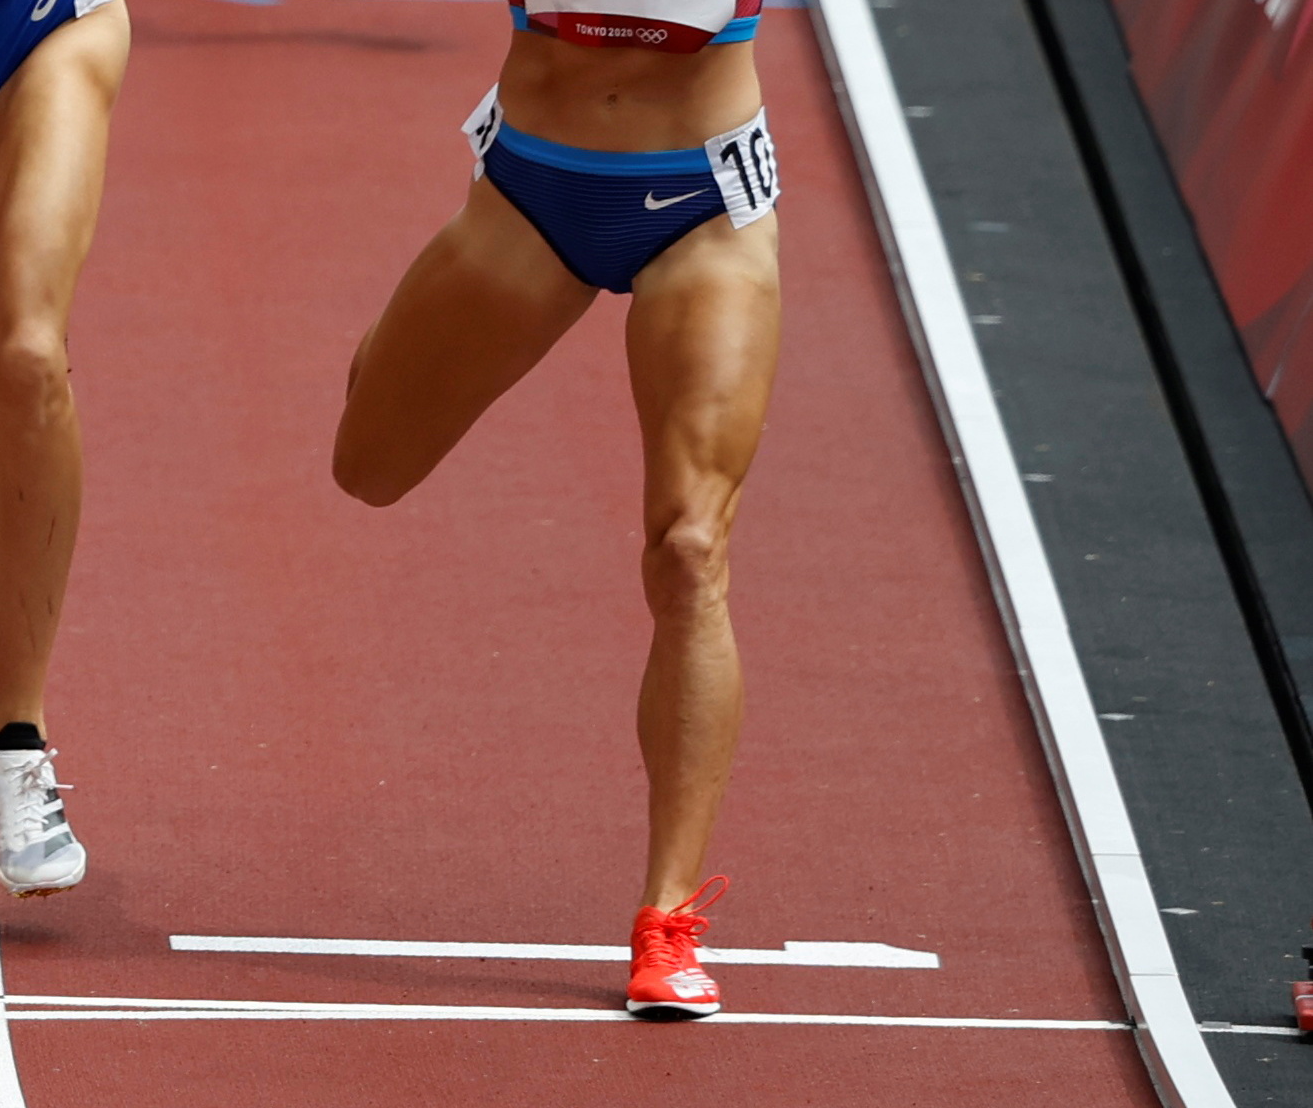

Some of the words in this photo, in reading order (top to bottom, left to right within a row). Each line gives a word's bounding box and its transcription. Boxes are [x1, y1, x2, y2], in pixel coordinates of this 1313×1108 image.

[576, 23, 607, 36] TOKYO
[608, 27, 633, 37] 2020
[720, 128, 774, 211] 10
[169, 935, 939, 968] 1
